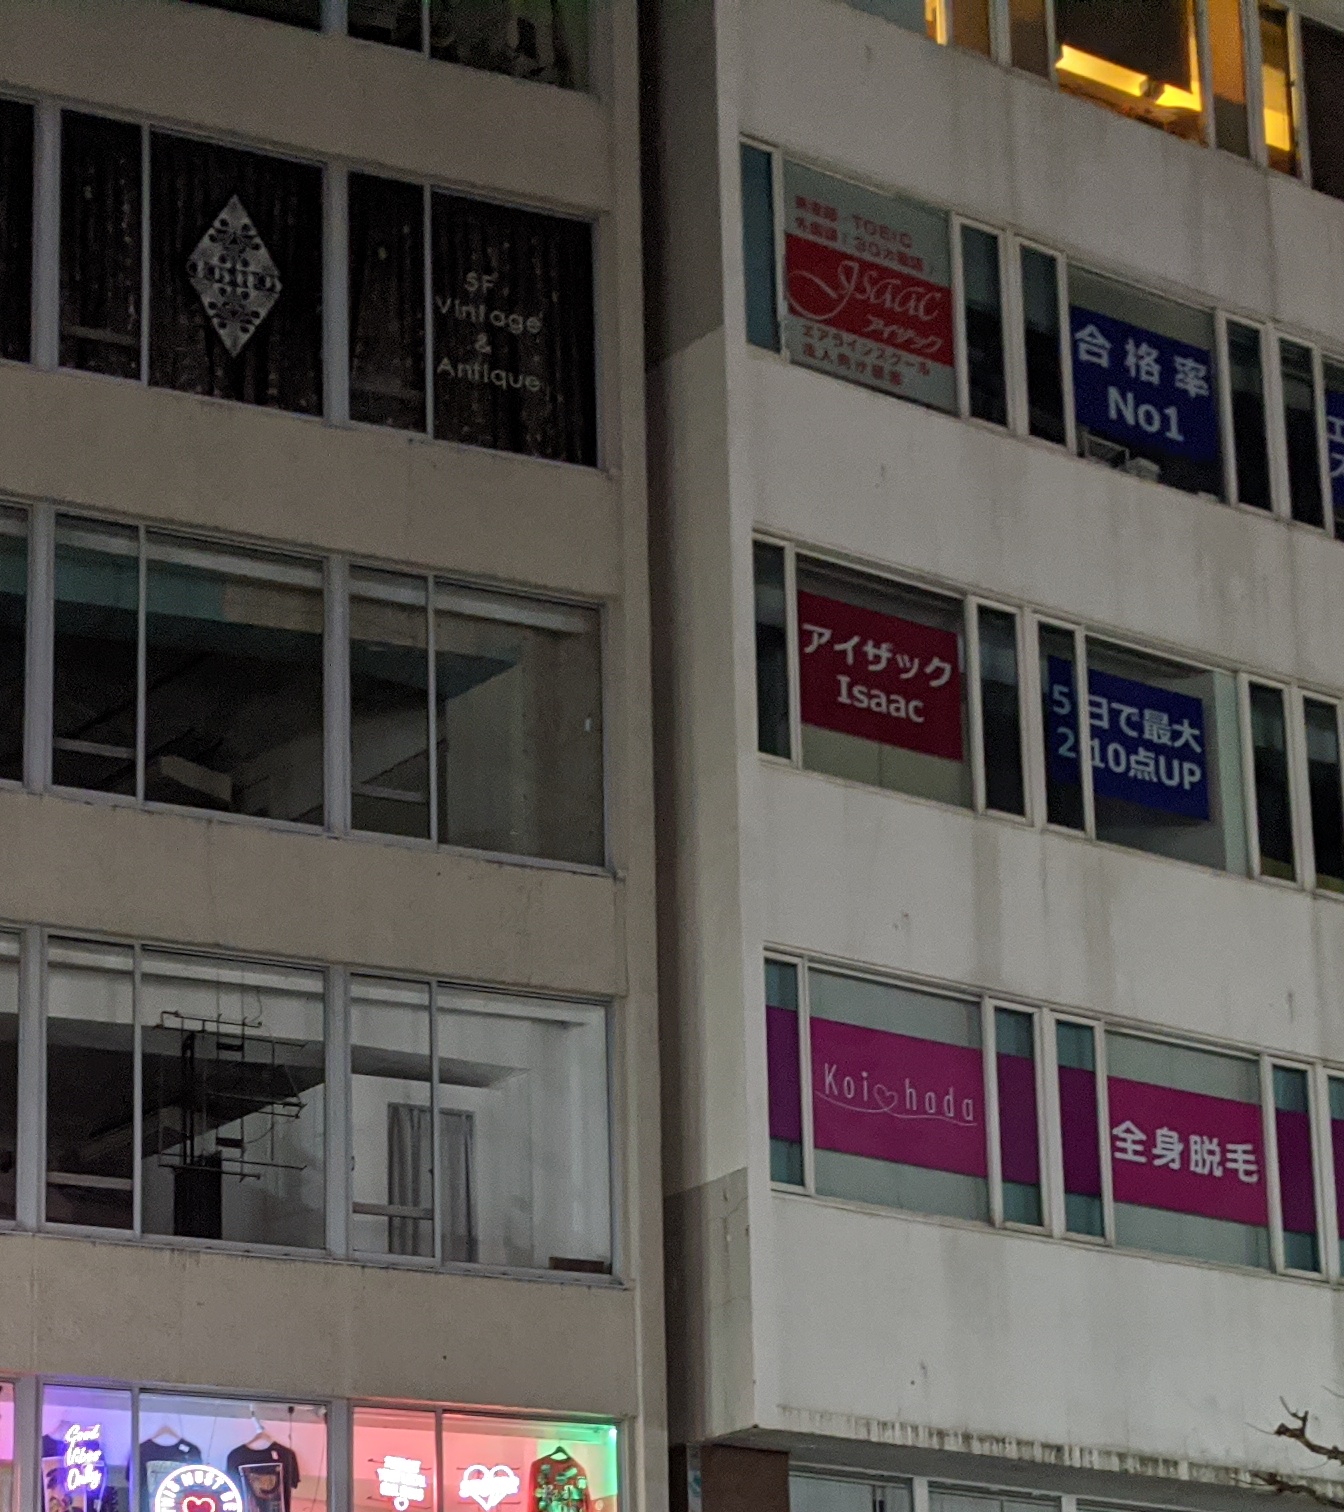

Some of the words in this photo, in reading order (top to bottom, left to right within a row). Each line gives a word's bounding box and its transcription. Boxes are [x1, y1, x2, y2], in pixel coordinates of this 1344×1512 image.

[463, 271, 498, 296] SF
[435, 294, 545, 335] Vintage
[435, 357, 542, 393] Antique
[1074, 324, 1210, 399] 合格率
[1106, 385, 1185, 443] No1
[802, 623, 954, 688] アイザック
[836, 674, 925, 724] Isaac
[1052, 683, 1203, 754] 5日で最大
[1057, 726, 1203, 792] 210点UP
[1111, 1120, 1261, 1184] 全身脱毛
[161, 1478, 181, 1512] THIS
[180, 1470, 223, 1491] MUST
[220, 1491, 239, 1512] BE
